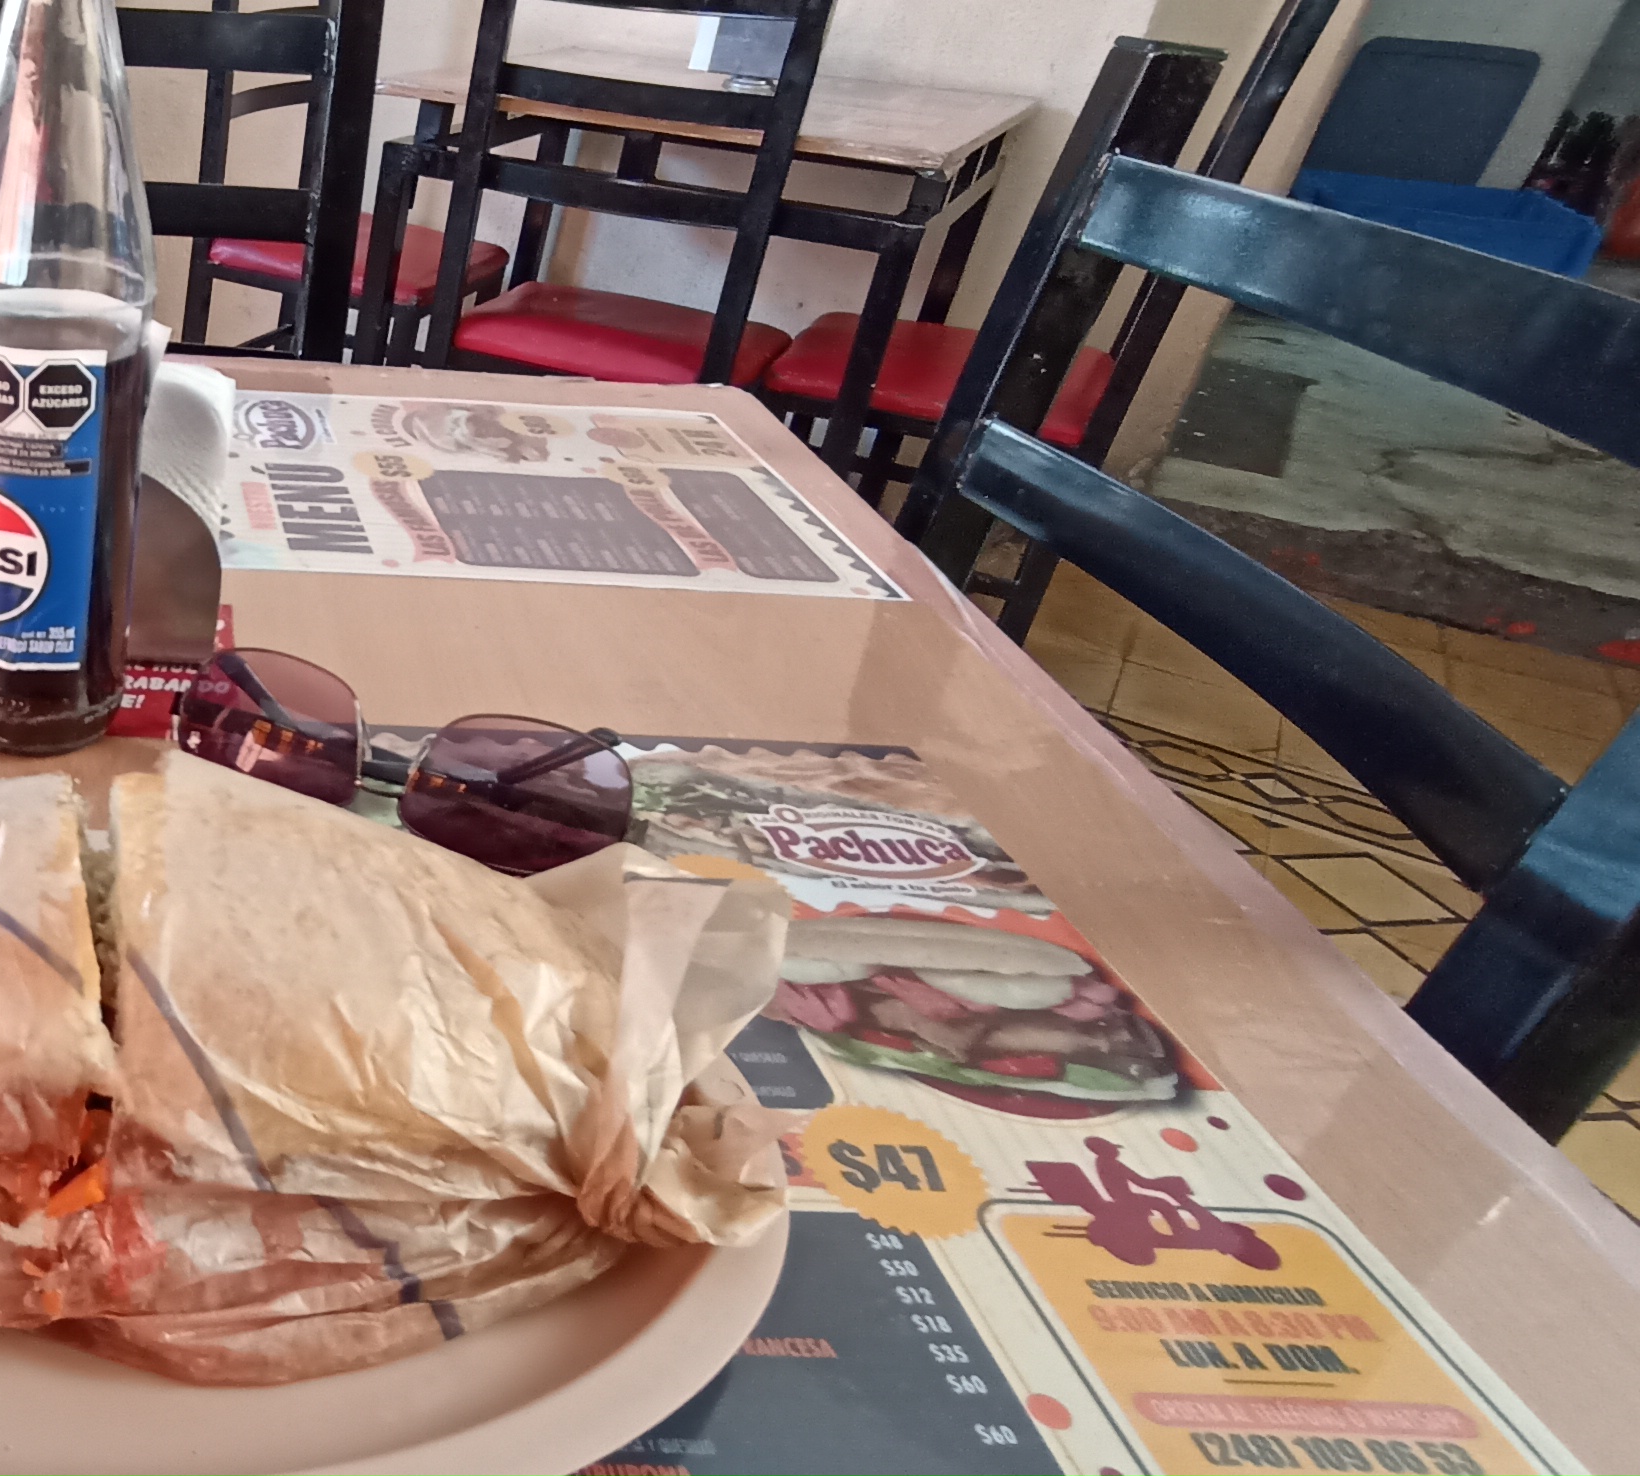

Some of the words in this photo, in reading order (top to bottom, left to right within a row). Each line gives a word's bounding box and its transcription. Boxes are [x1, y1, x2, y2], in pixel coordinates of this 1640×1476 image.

[39, 384, 83, 395] EXCESO
[250, 463, 374, 554] MENÚ
[763, 826, 972, 865] Pachuca
[827, 1138, 947, 1193] $47
[879, 1258, 920, 1277] $50
[895, 1286, 936, 1305] $12
[1085, 1279, 1190, 1300] SERVICIO
[1187, 1282, 1214, 1302] A
[1205, 1283, 1326, 1306] DOMICILIO
[911, 1314, 952, 1334] $18
[1162, 1307, 1221, 1336] AM
[1217, 1309, 1251, 1337] A
[1316, 1312, 1381, 1341] PM
[928, 1343, 970, 1364] $35
[1160, 1339, 1240, 1370] LUN.
[1231, 1341, 1269, 1371] A
[1262, 1342, 1361, 1375] DOM.
[945, 1373, 988, 1394] $60
[974, 1423, 1018, 1445] $60
[1190, 1432, 1301, 1468] (248)
[1292, 1436, 1372, 1472] 109
